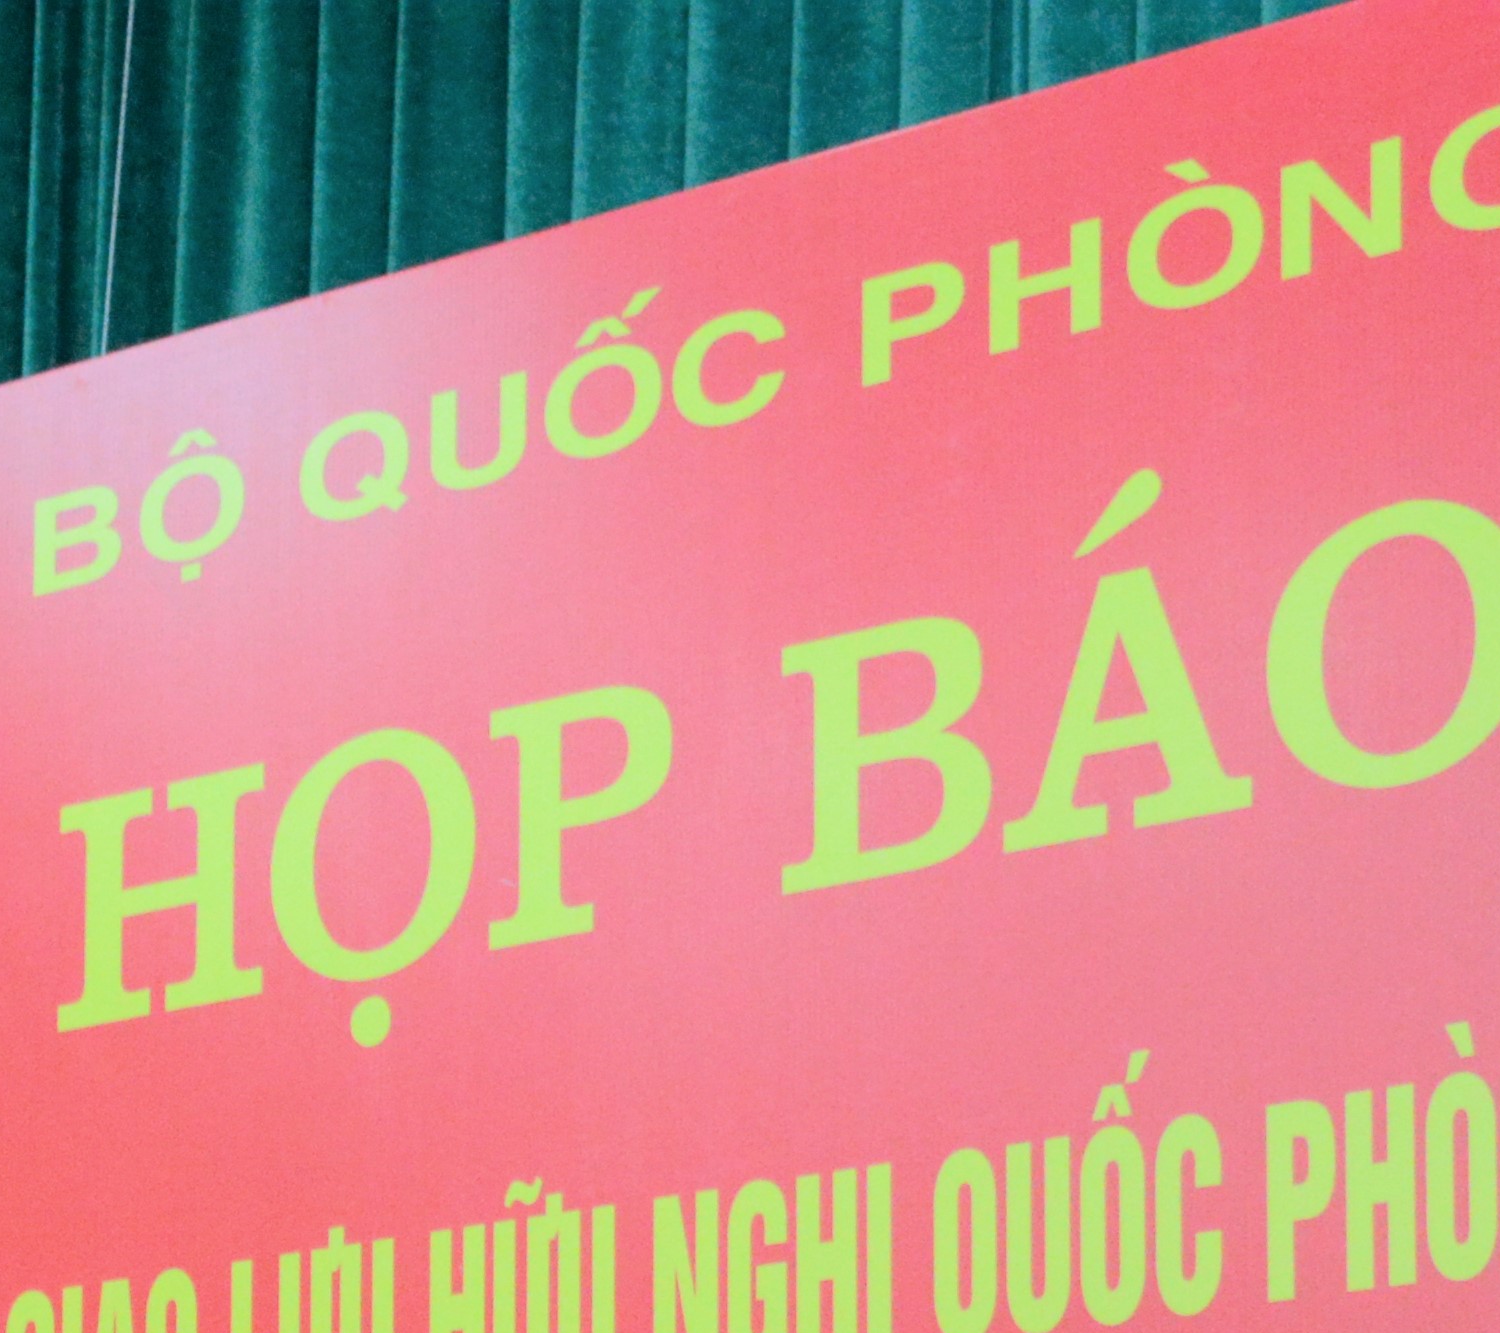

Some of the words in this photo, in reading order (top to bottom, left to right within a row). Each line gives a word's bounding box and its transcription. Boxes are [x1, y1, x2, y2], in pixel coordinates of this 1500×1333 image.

[33, 427, 246, 597] BỘ
[298, 286, 785, 521] QUỐC
[58, 685, 673, 1048] HỌP
